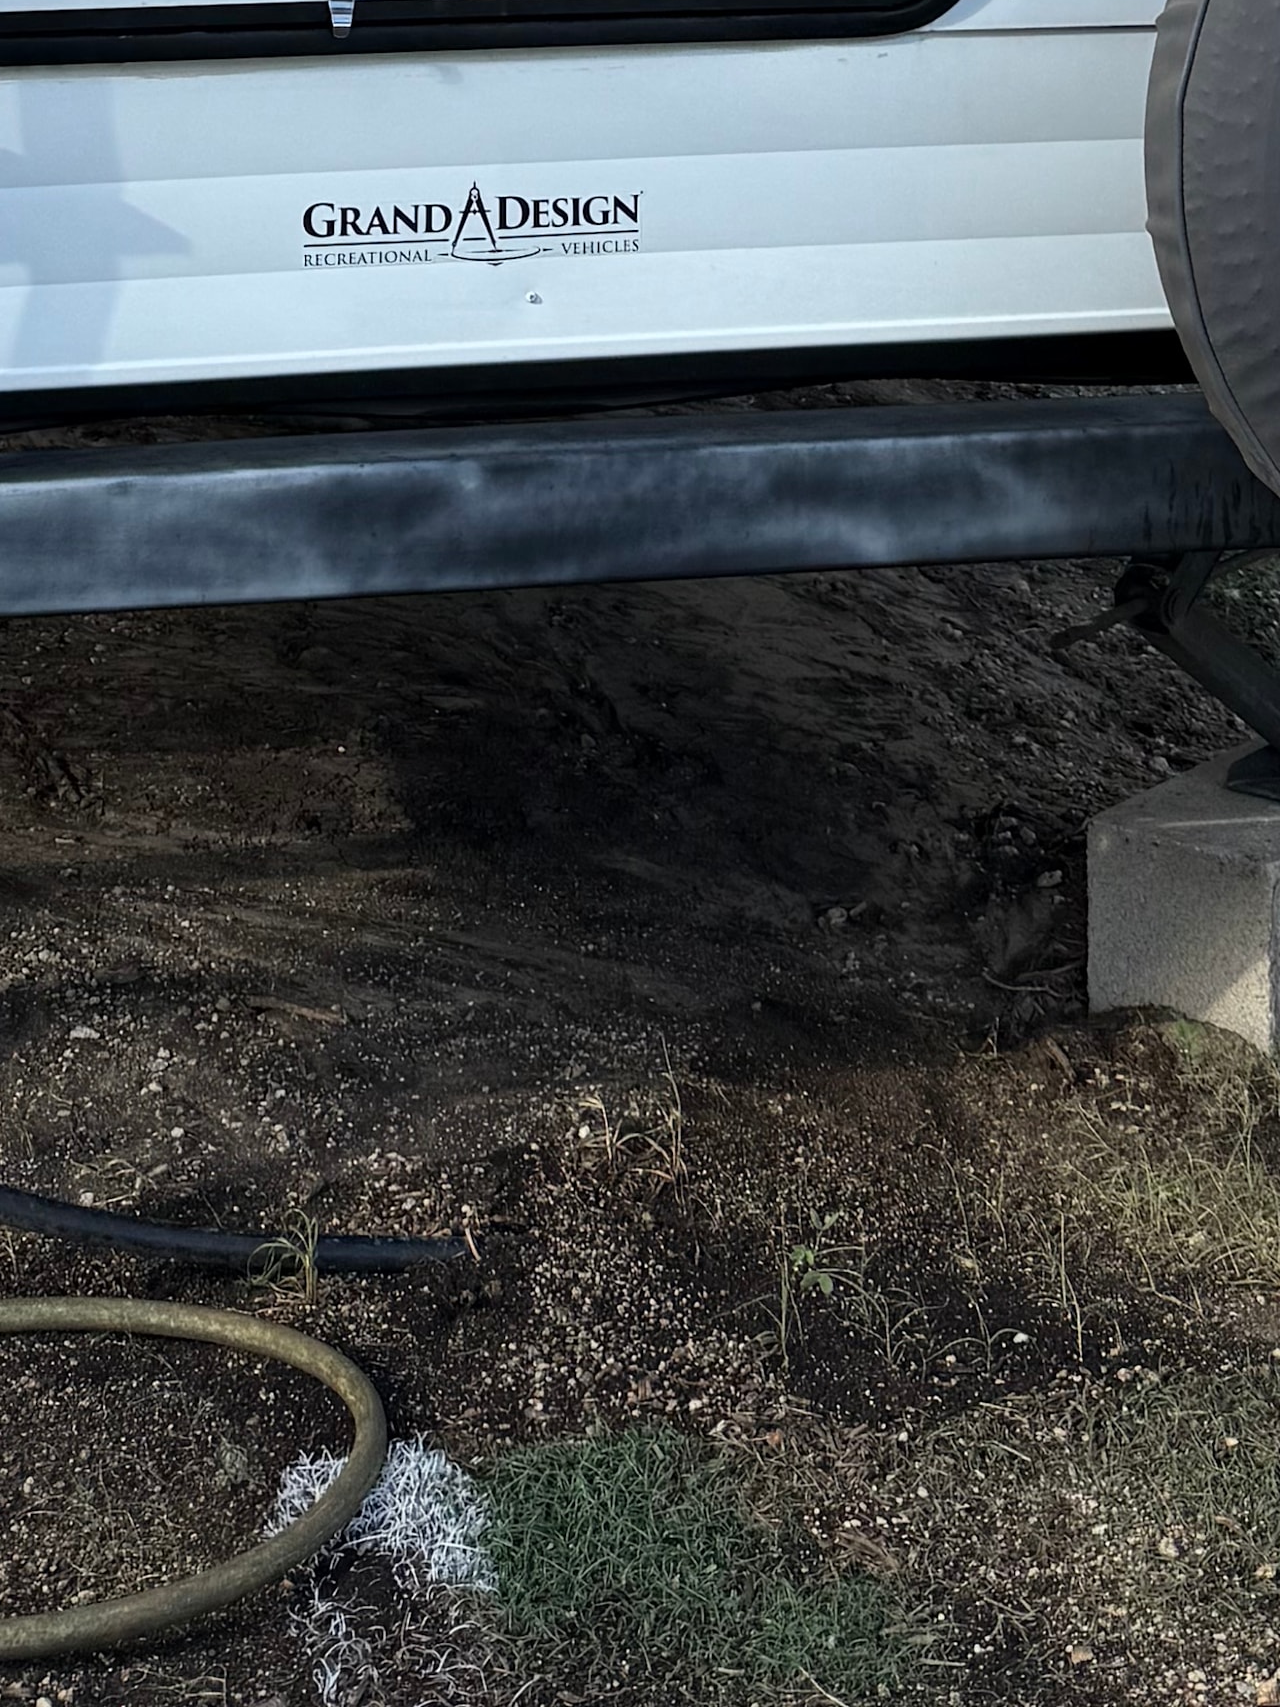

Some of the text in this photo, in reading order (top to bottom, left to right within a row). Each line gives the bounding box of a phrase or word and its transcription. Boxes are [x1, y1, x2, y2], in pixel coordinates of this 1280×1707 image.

[302, 194, 640, 239] GRAND DESIGN
[303, 239, 640, 267] RECREATIONAL VEHICLES
